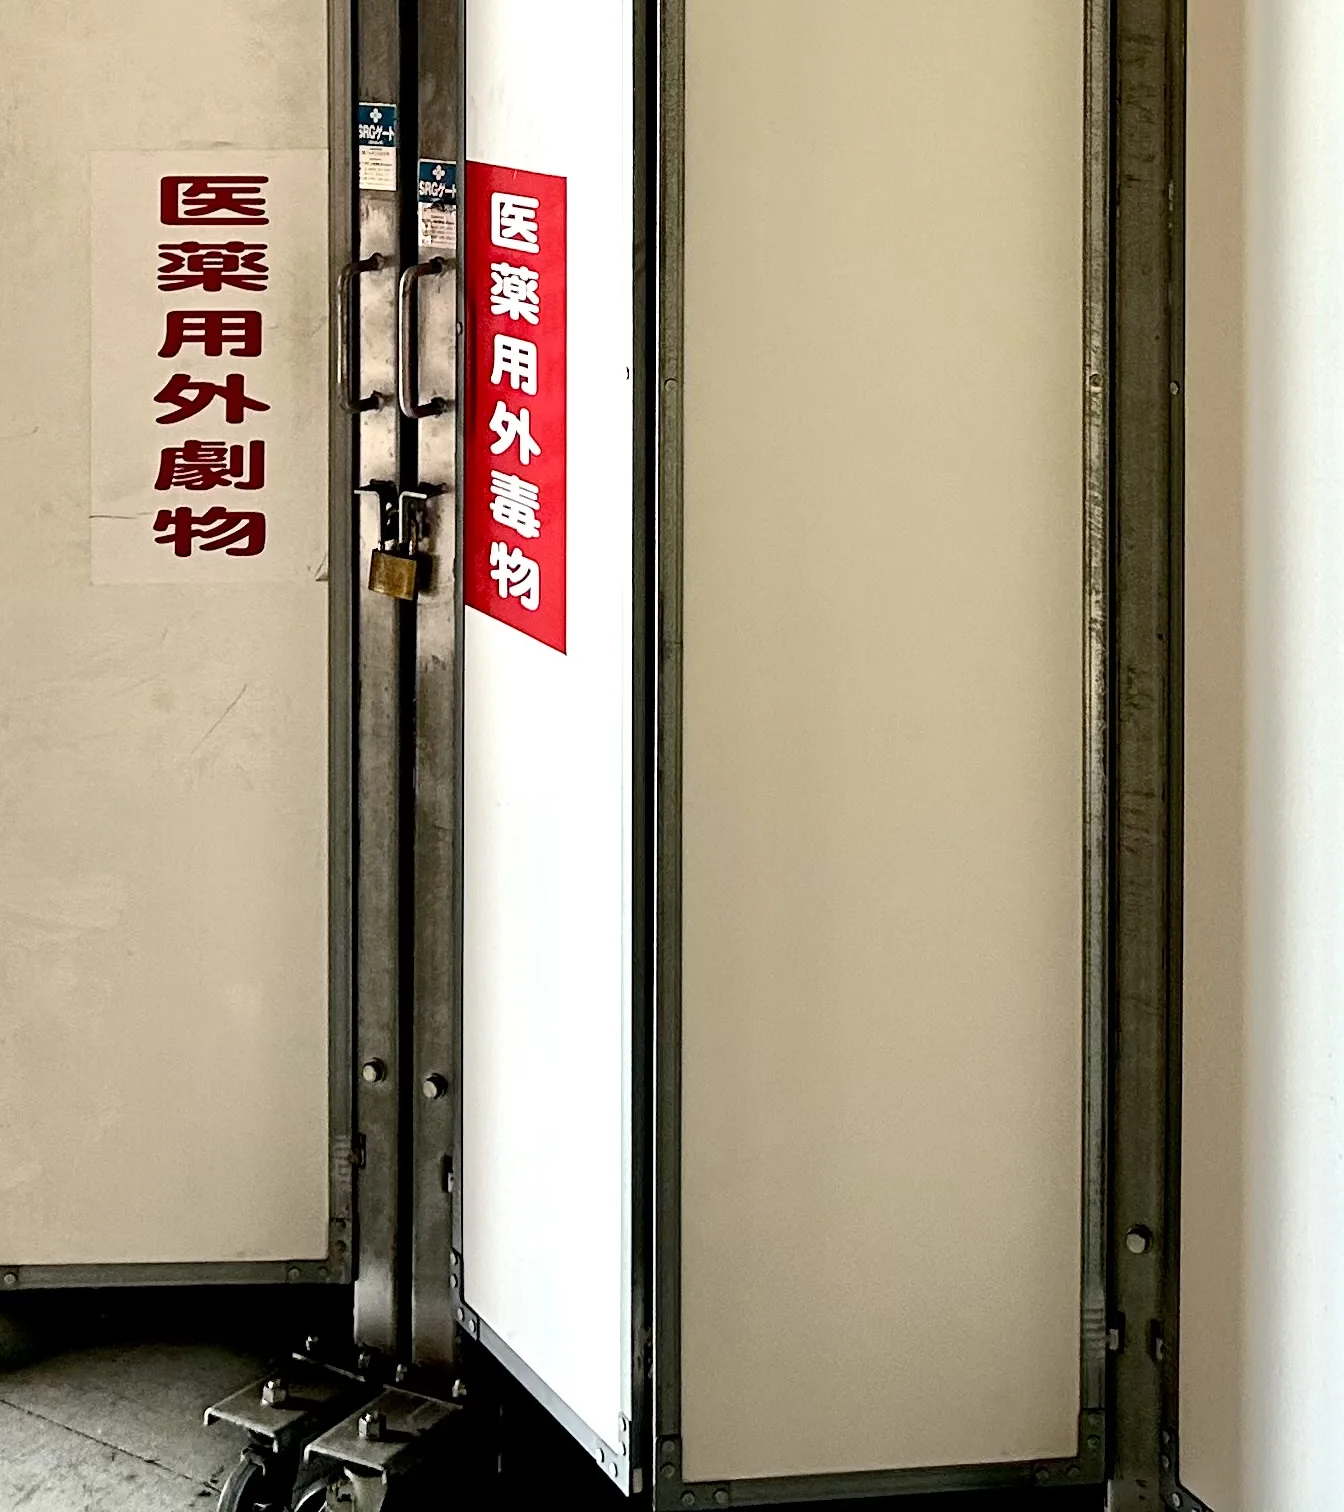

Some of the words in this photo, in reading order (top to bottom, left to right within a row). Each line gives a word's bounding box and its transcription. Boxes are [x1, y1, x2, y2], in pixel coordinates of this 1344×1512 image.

[153, 175, 270, 557] 医薬用外劇物
[489, 192, 541, 611] 医薬用外毒物
